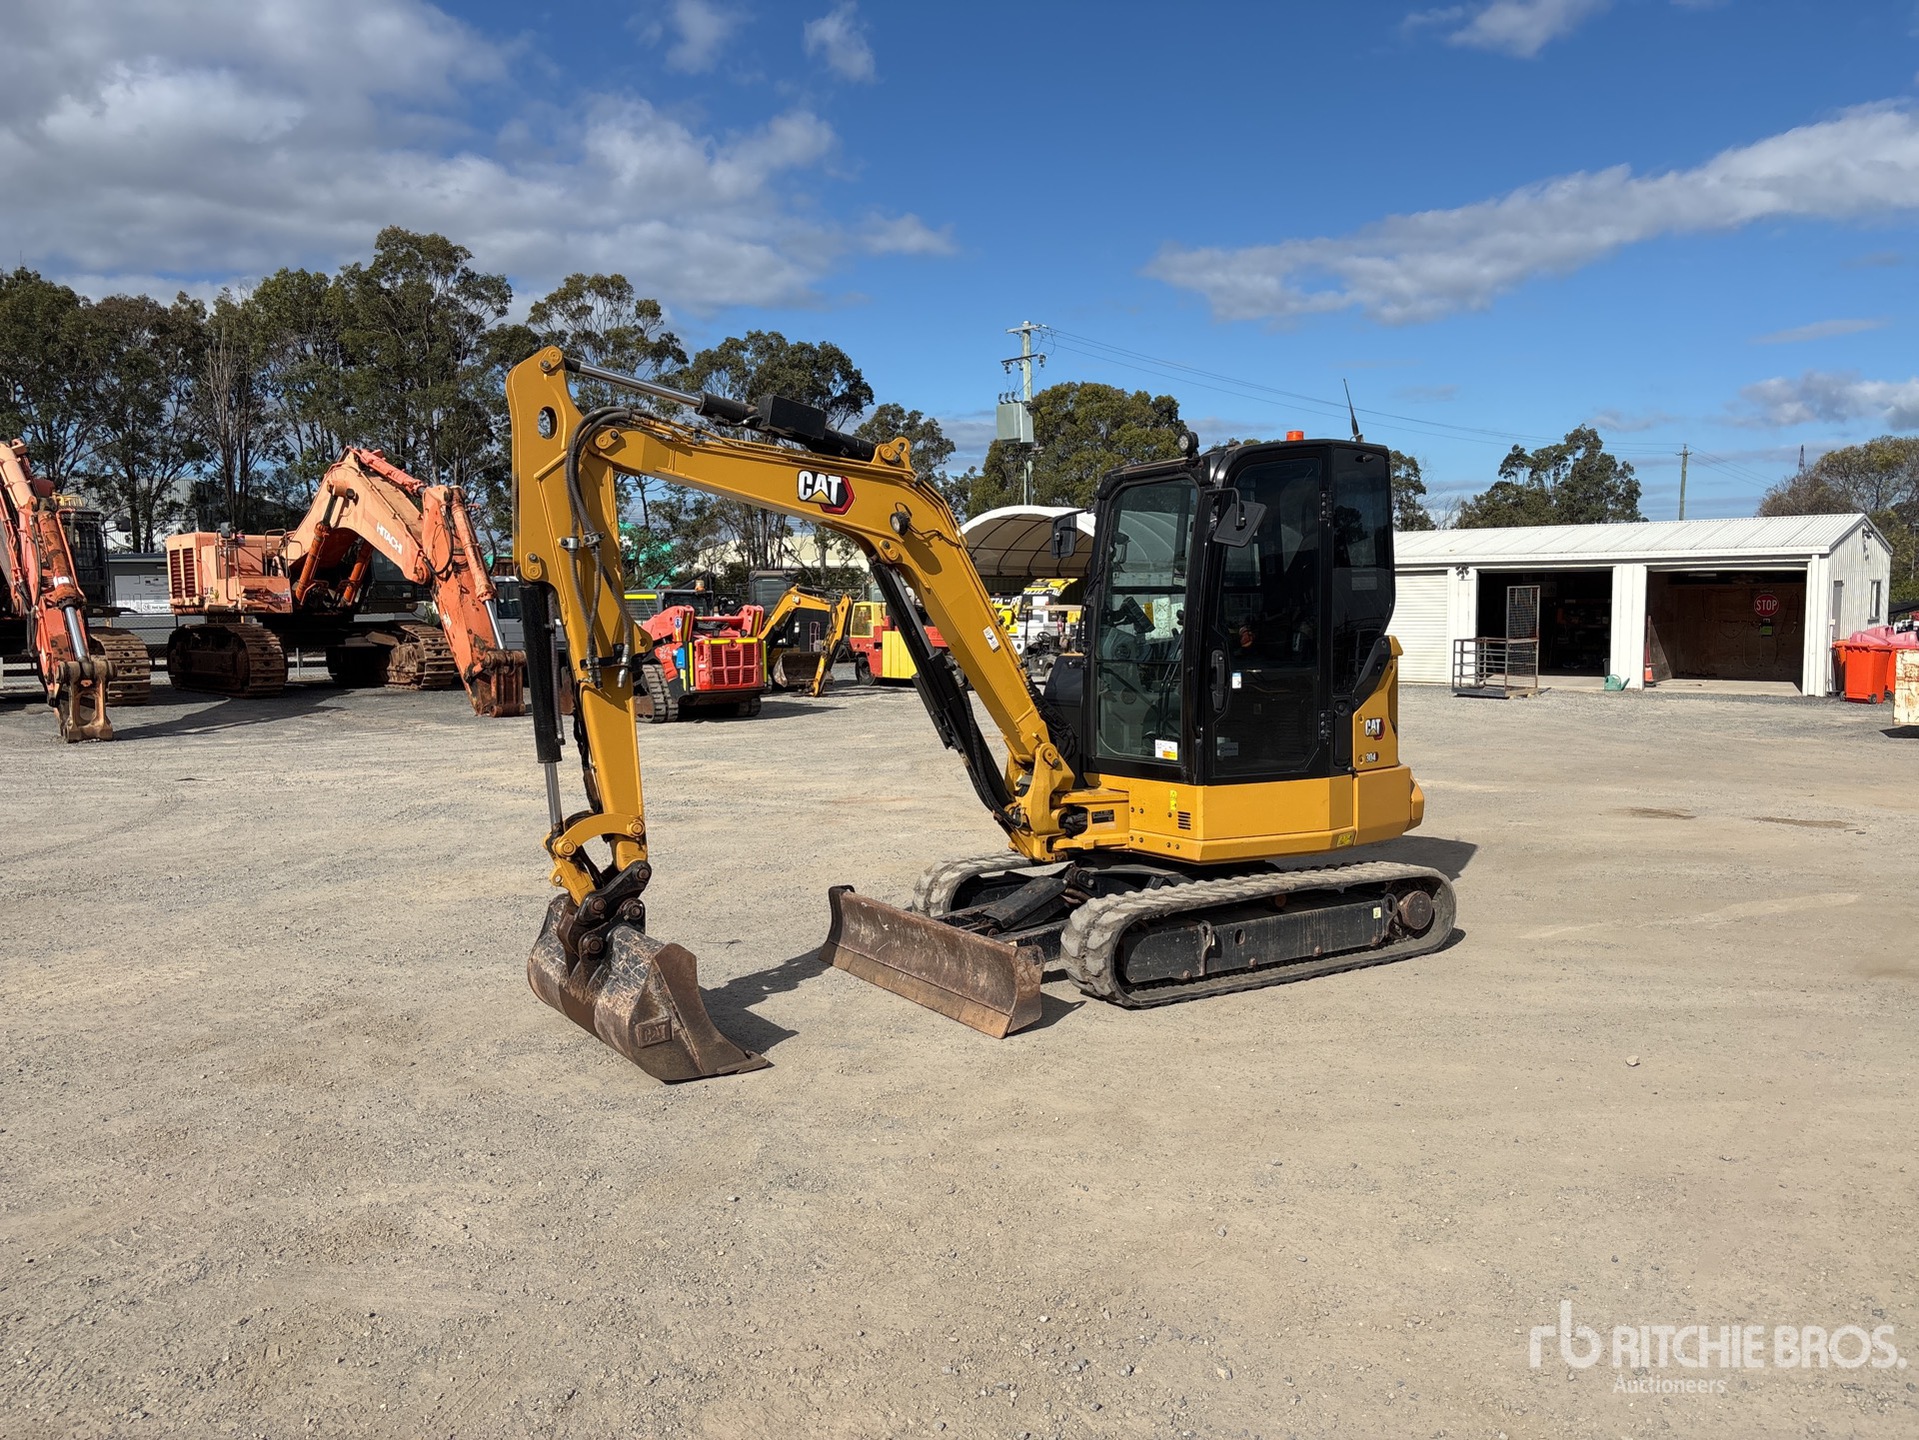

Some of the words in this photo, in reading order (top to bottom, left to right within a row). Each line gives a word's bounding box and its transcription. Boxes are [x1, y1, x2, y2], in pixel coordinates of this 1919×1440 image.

[798, 470, 842, 505] CAT
[376, 521, 403, 556] HITACHI
[1756, 599, 1778, 611] STOP
[1365, 718, 1381, 736] CAT
[1365, 752, 1377, 762] 304
